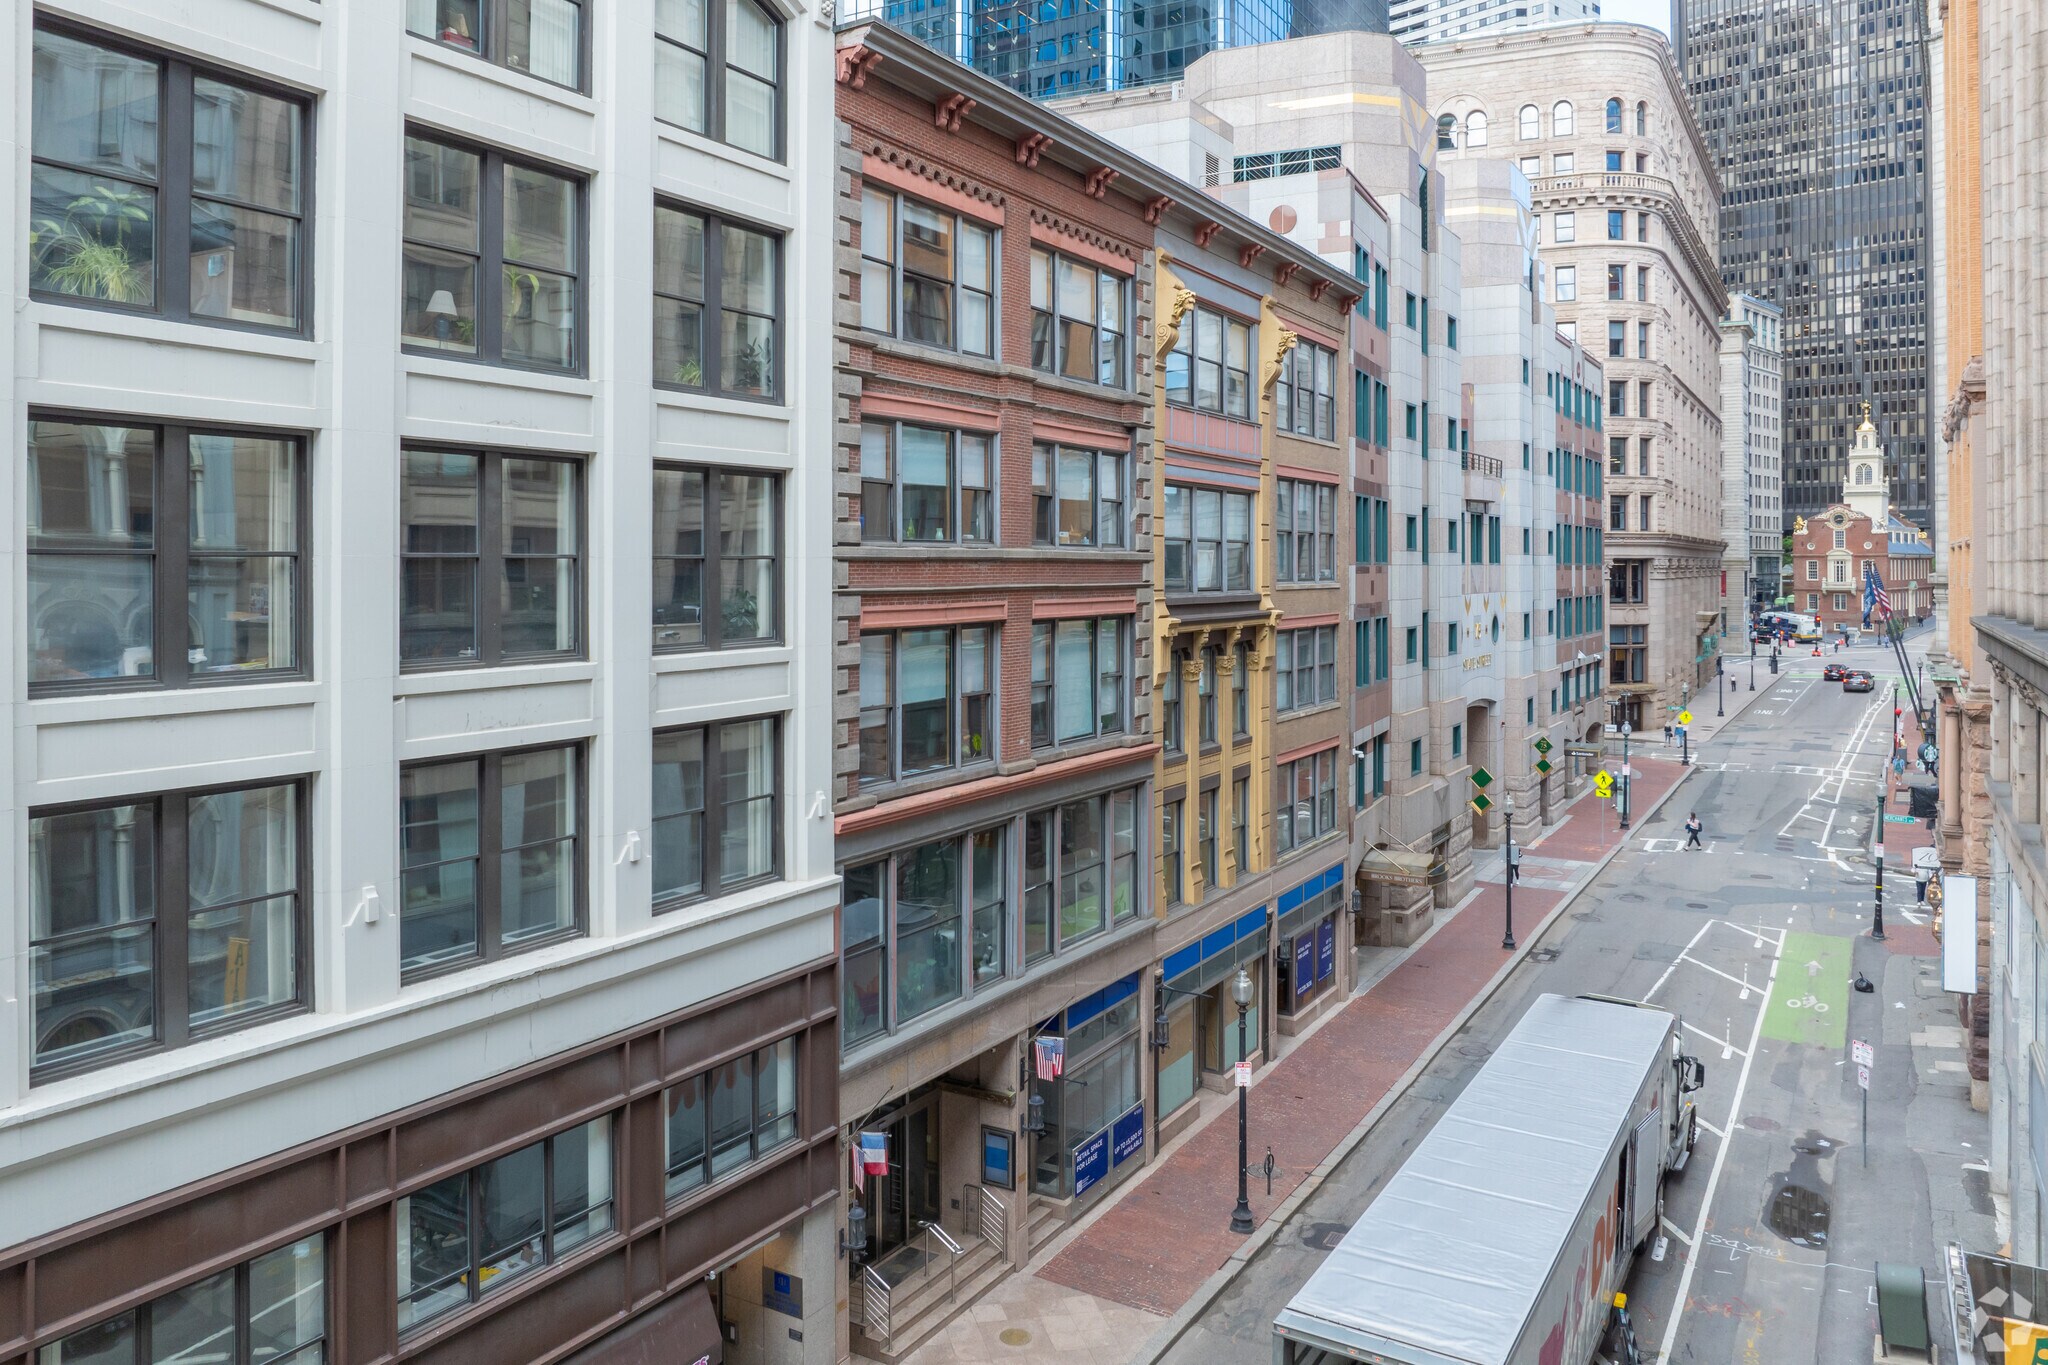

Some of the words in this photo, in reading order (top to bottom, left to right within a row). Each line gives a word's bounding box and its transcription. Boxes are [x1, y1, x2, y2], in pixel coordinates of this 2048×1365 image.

[1394, 875, 1422, 883] BROTHERS
[1077, 1150, 1090, 1163] RETAIL
[1090, 1139, 1103, 1153] SPACE
[1114, 1146, 1120, 1155] UP
[1120, 1142, 1126, 1151] TO
[1138, 1128, 1142, 1137] SF
[1123, 1136, 1142, 1157] AVAILABLE
[1077, 1160, 1085, 1172] FOR
[1086, 1152, 1098, 1166] LEASE
